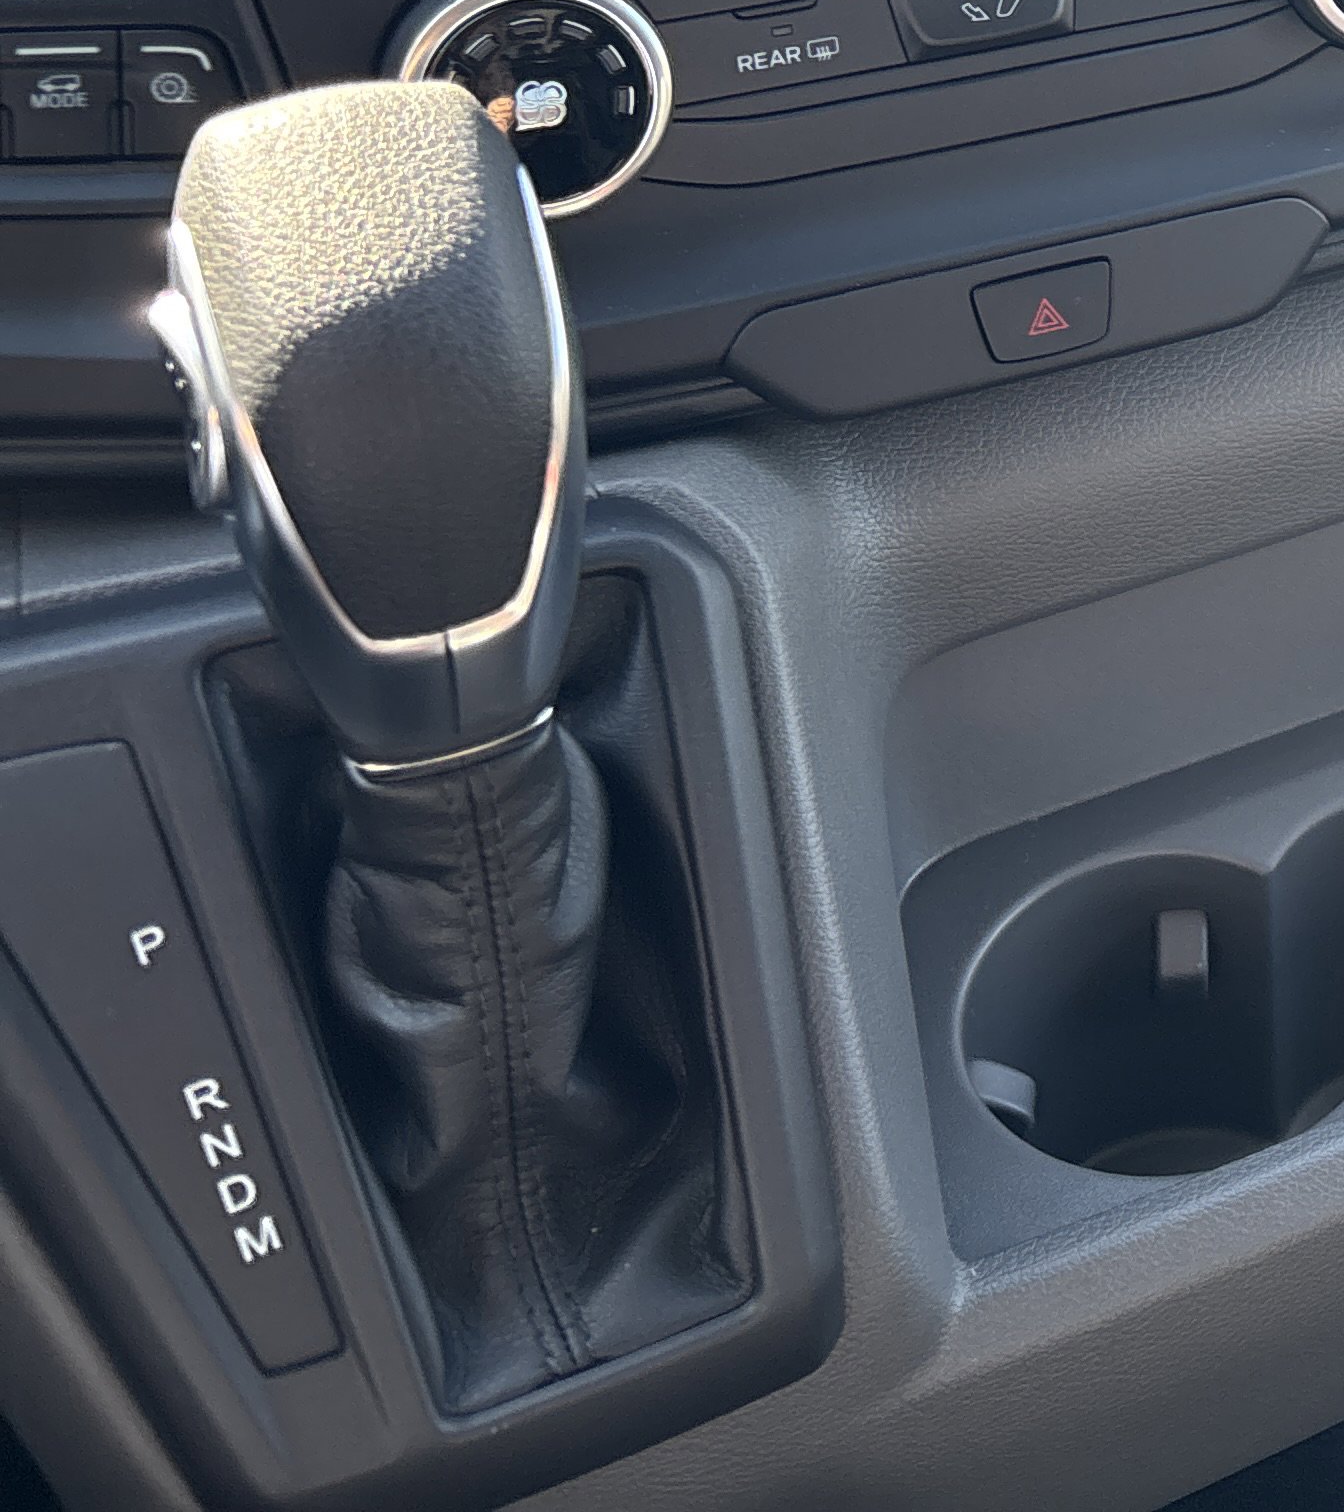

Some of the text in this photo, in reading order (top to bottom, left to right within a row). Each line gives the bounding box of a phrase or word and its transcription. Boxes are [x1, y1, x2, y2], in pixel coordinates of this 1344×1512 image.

[737, 45, 802, 73] REAR
[29, 92, 90, 109] MODE
[131, 925, 283, 1263] P R N D M
